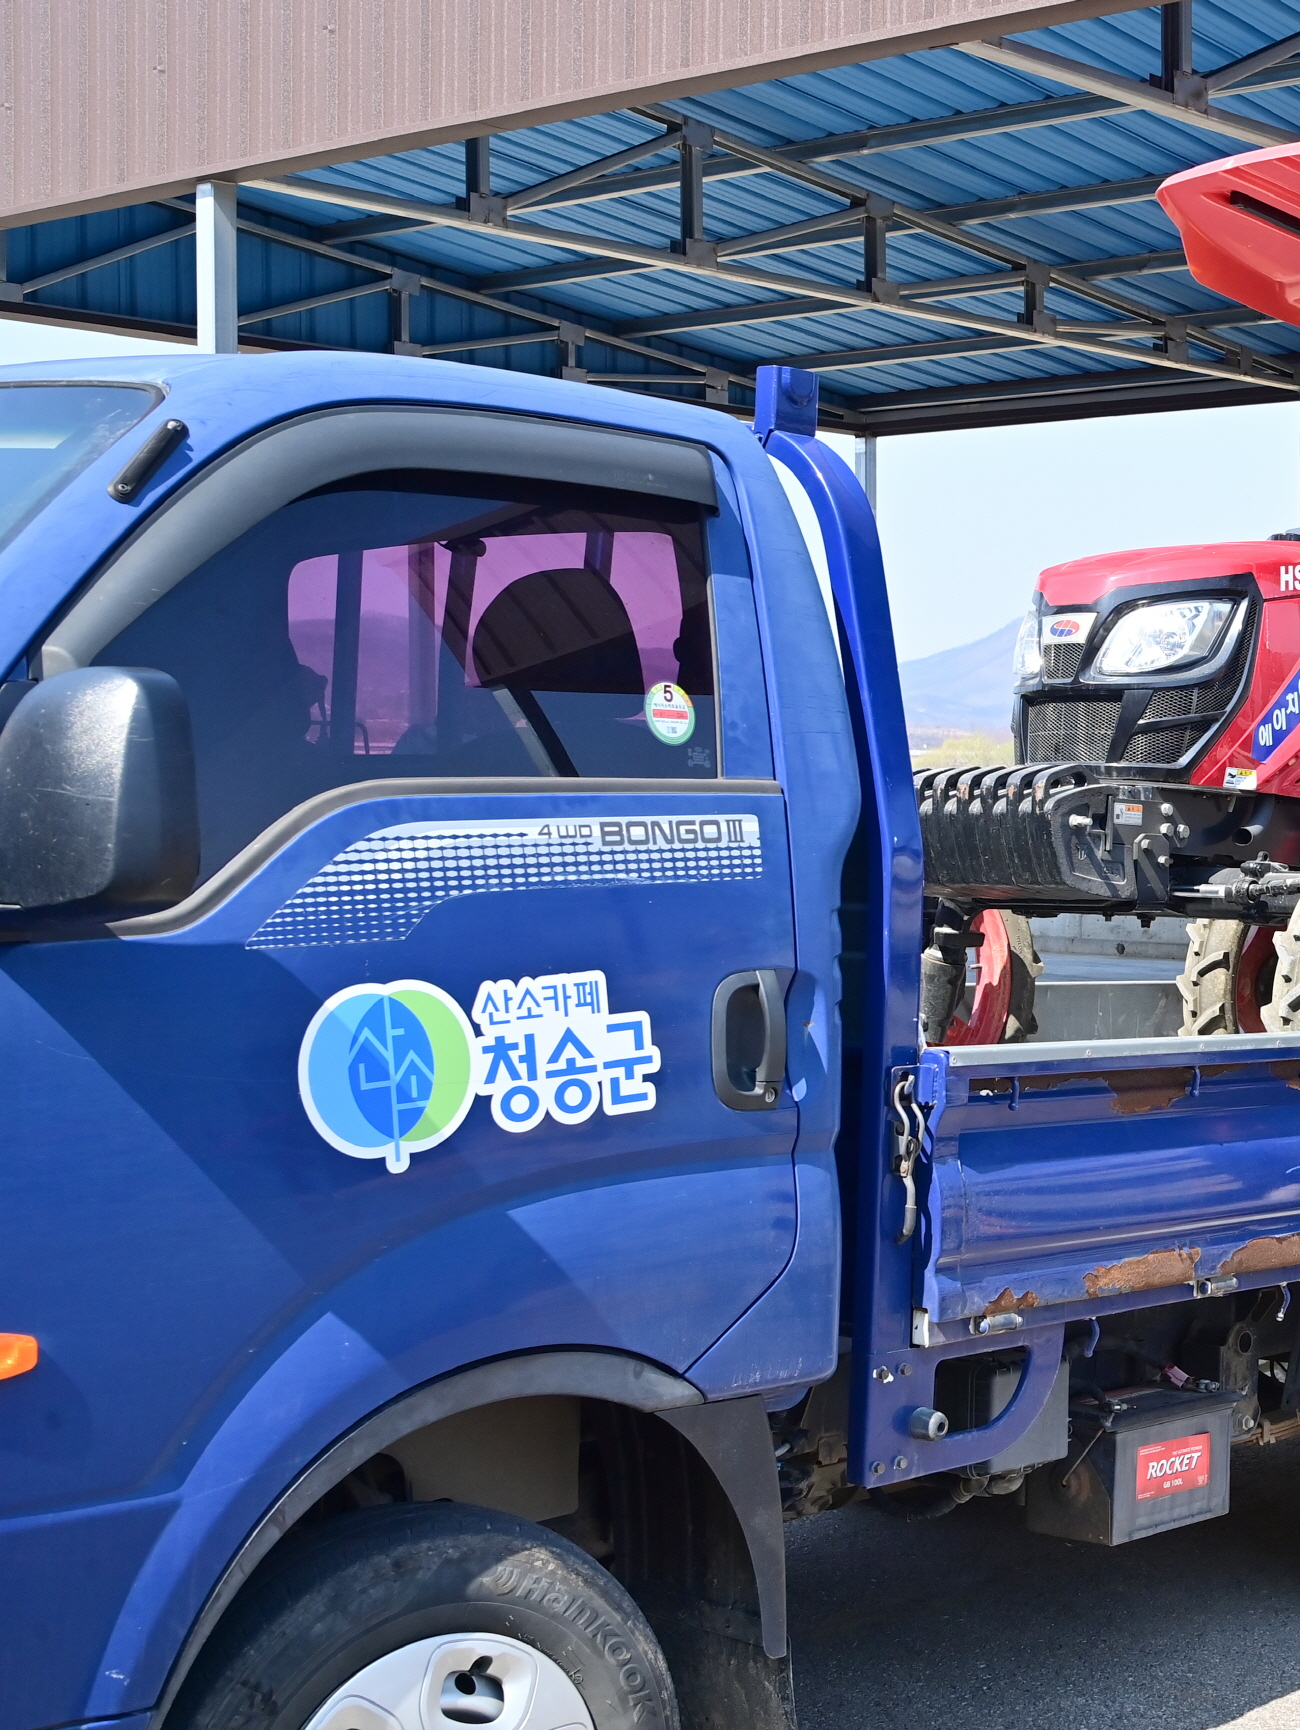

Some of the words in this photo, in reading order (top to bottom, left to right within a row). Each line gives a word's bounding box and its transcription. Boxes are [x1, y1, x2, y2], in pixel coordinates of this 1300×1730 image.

[663, 684, 674, 703] 5
[538, 823, 592, 840] 4WD
[601, 819, 722, 847] BONGO
[481, 980, 603, 1027] 산소카페
[481, 1020, 654, 1123] 청송군
[1146, 1451, 1202, 1480] ROCKET
[515, 1574, 658, 1725] Hankook
